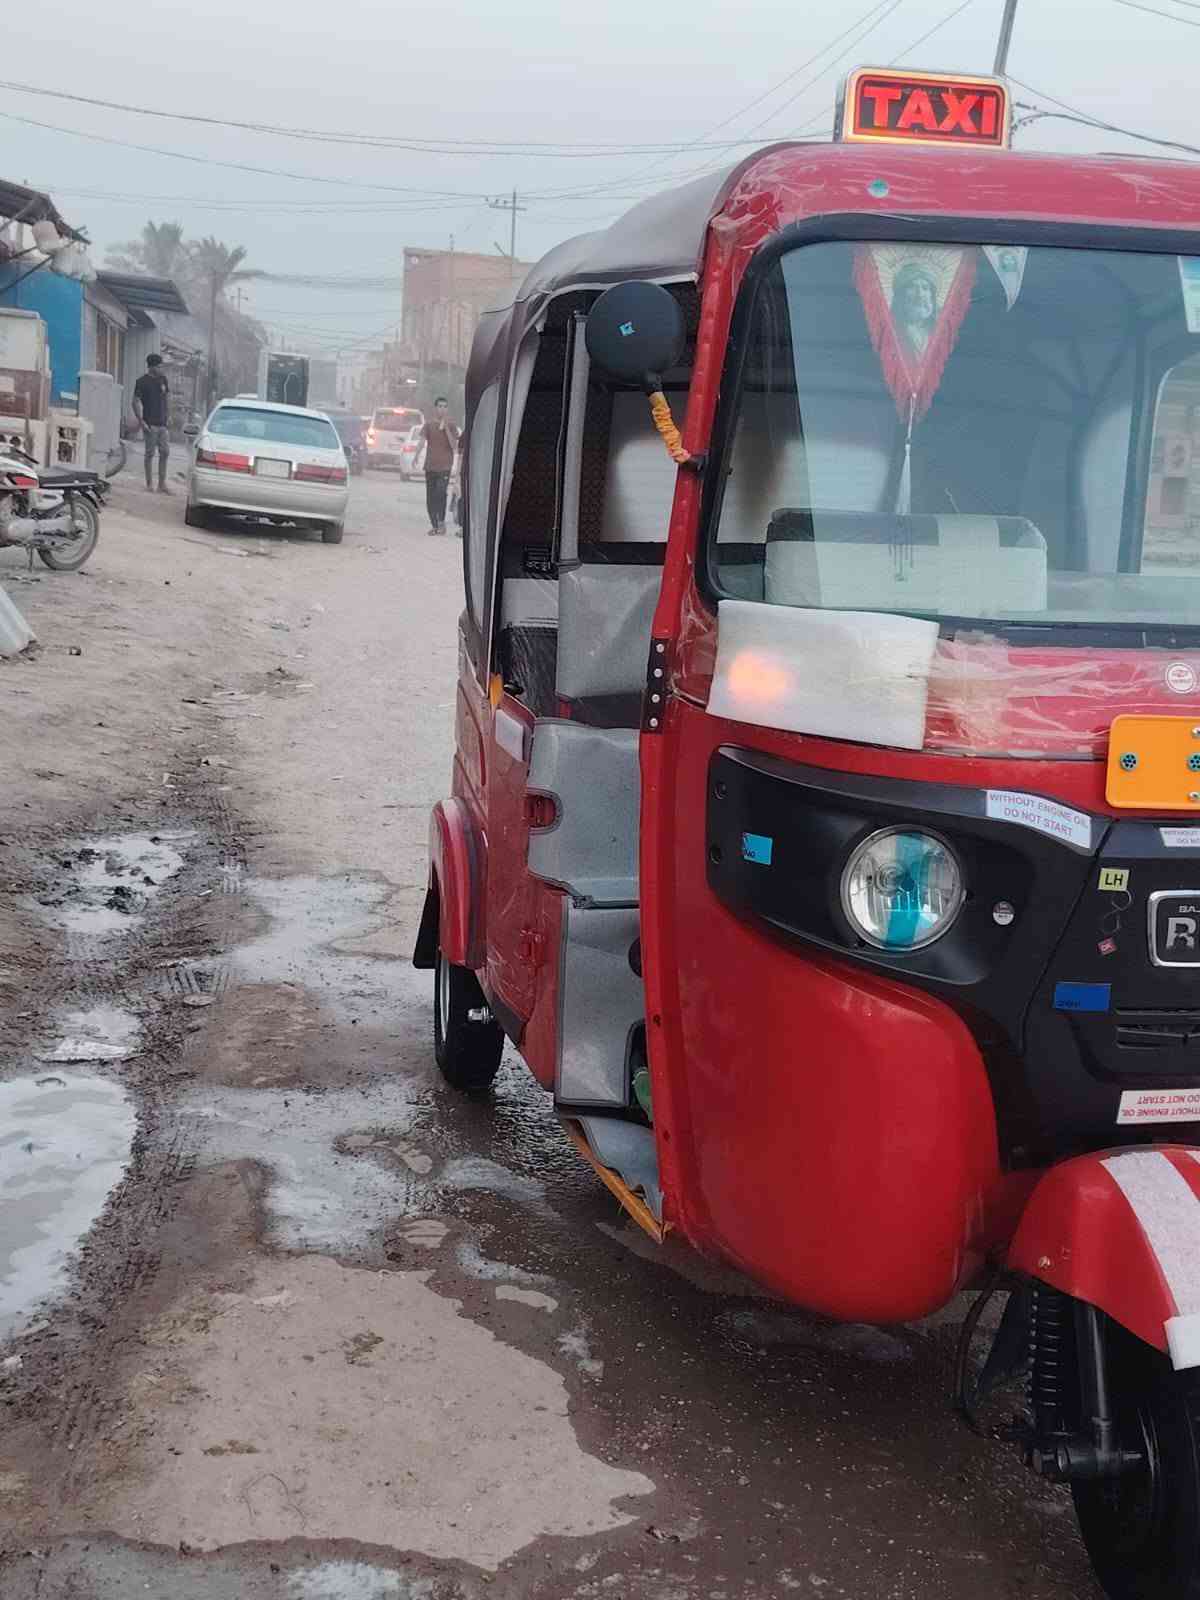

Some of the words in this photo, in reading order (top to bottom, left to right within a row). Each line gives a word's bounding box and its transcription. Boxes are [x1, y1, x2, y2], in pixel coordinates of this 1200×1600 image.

[863, 86, 997, 135] TAXI
[990, 793, 1034, 807] WITHOUT
[1038, 802, 1073, 820] ENGINE
[1004, 807, 1019, 818] DO
[1022, 810, 1041, 823] NOT
[1043, 818, 1073, 837] START
[1104, 872, 1124, 886] LH
[1137, 1096, 1166, 1105] START
[1167, 1095, 1185, 1104] NOT
[1136, 1108, 1169, 1117] ENGINE
[1170, 1107, 1200, 1117] ITHOUT
